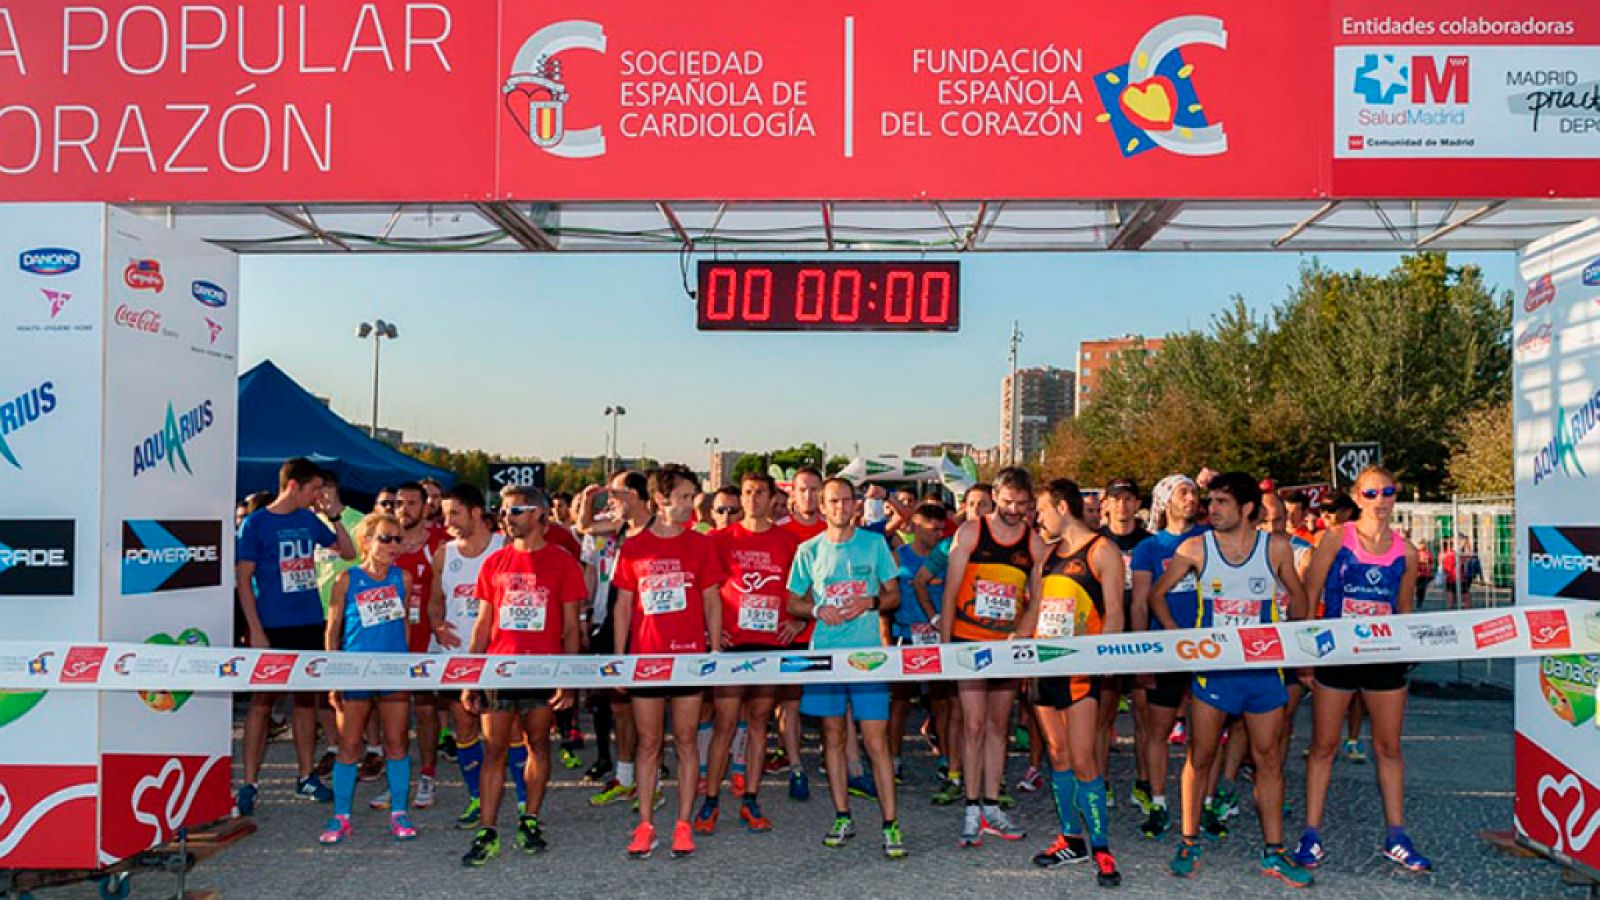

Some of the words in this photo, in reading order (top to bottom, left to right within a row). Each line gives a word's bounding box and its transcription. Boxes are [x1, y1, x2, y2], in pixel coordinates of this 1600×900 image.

[1342, 16, 1436, 35] Entidades
[1439, 16, 1575, 35] colaboradoras
[62, 3, 453, 76] POPULAR
[620, 50, 763, 76] SOCIEDAD
[912, 44, 1083, 73] FUNDACIÓN
[620, 77, 763, 107] ESPAÑOLA
[773, 81, 808, 106] DE
[938, 76, 1083, 105] ESPAÑOLA
[1506, 71, 1579, 87] MADRID
[0, 83, 332, 174] ORAZÓN
[619, 107, 816, 138] CARDIOLOGÍA
[881, 111, 932, 137] DEL
[940, 106, 1083, 137] CORAZÓN
[1358, 109, 1465, 126] SaludMadrid
[1366, 138, 1423, 147] Comunidad
[1425, 138, 1438, 147] de
[1441, 138, 1475, 147] Madrid
[22, 254, 77, 266] DANONE
[706, 268, 773, 321] 00
[132, 399, 215, 477] AQUARIUS
[124, 545, 219, 566] POWERADE
[1222, 613, 1251, 626] 717
[1096, 641, 1165, 656] PHILIPS
[1175, 638, 1222, 661] GO
